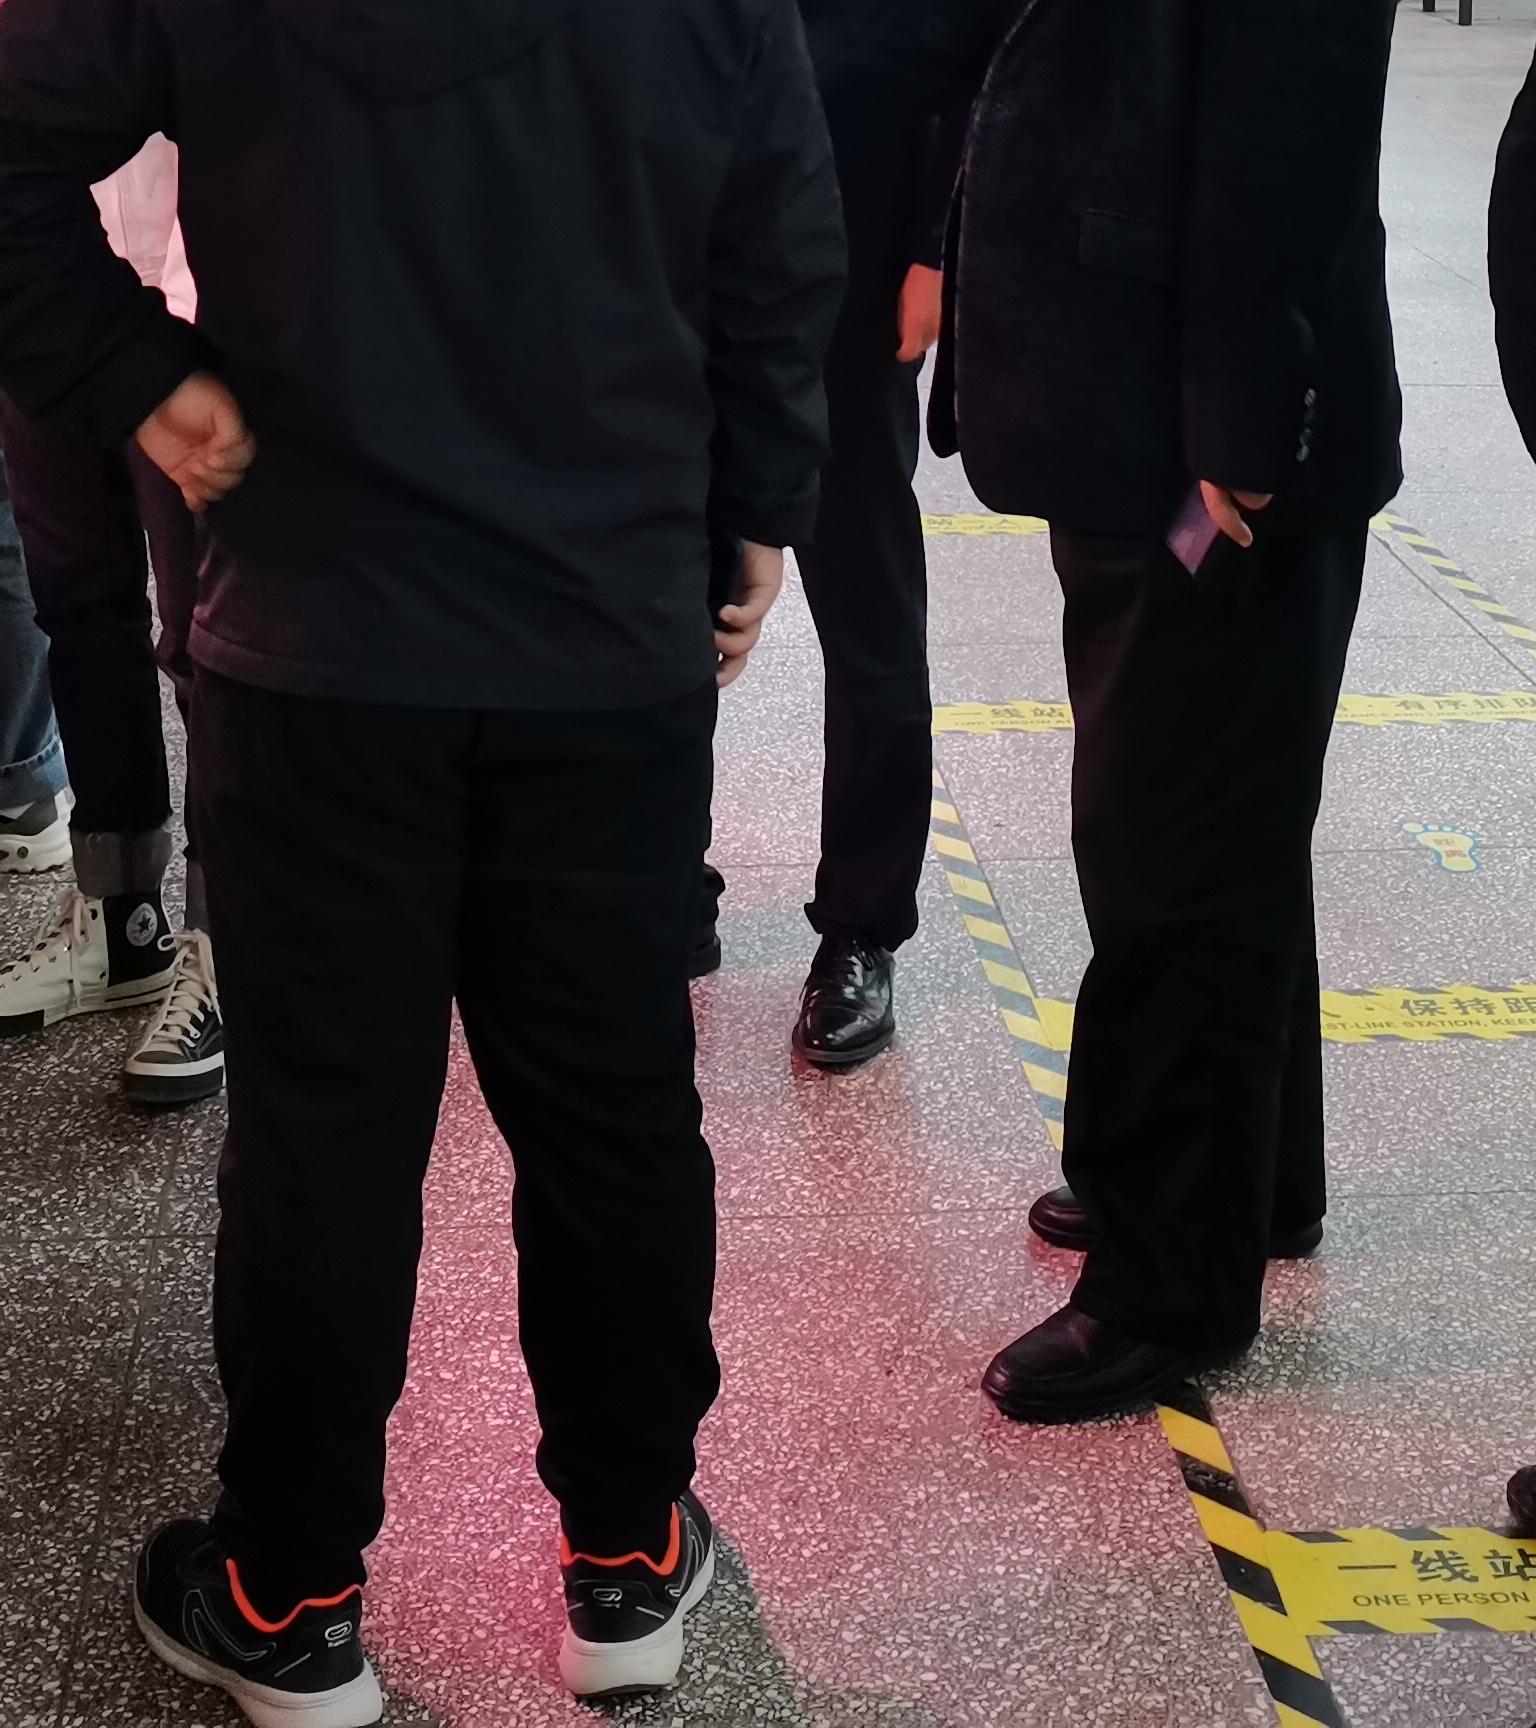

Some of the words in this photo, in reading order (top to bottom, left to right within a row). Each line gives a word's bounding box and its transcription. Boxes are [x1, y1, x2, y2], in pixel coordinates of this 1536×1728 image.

[1405, 1018, 1488, 1030] STATION,
[1352, 1593, 1410, 1608] ONE
[1417, 1591, 1530, 1607] PERSON
